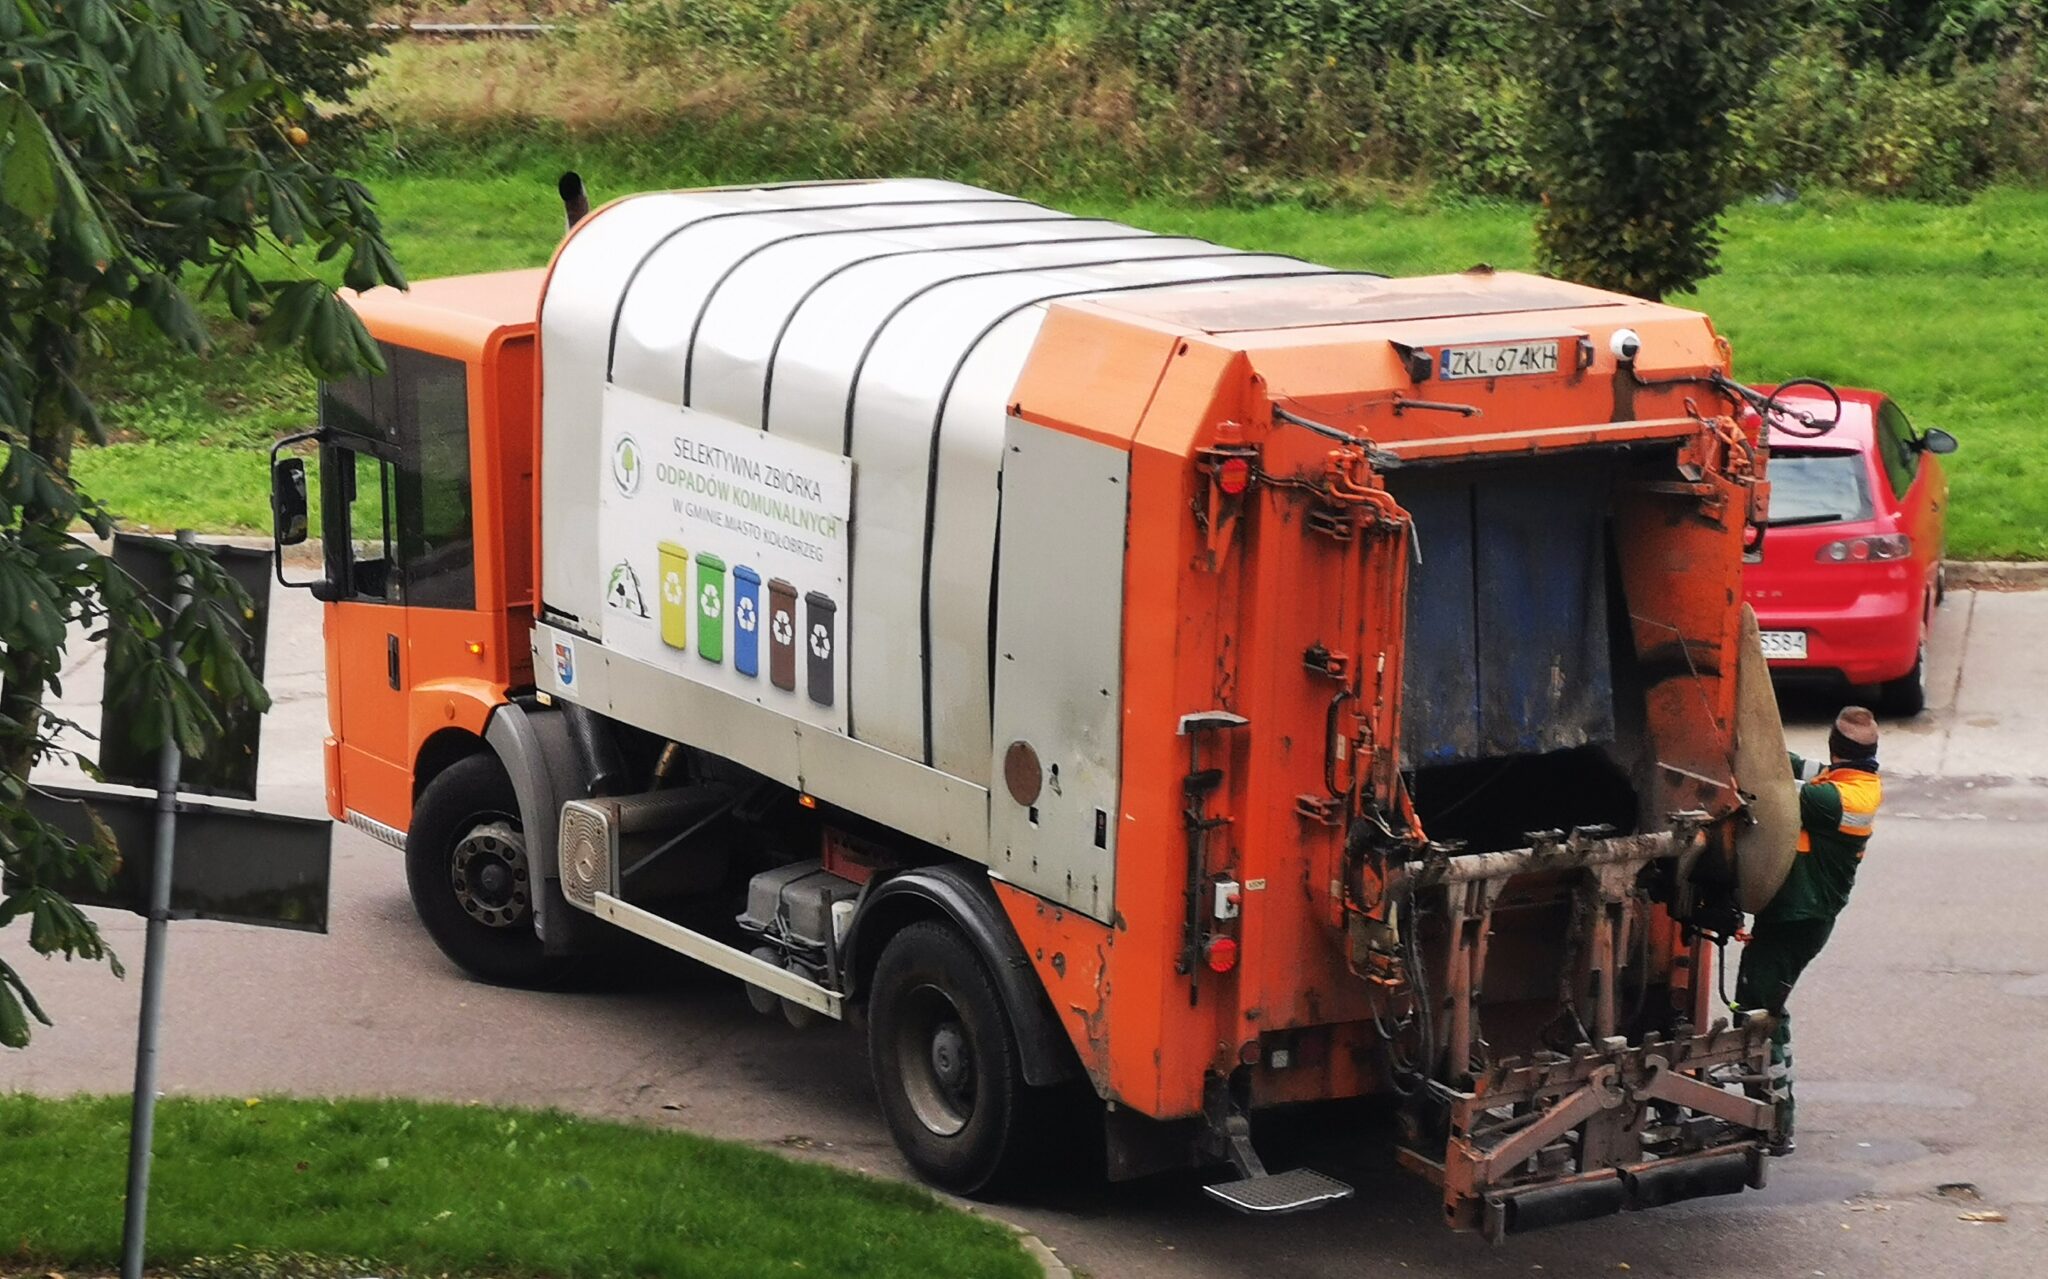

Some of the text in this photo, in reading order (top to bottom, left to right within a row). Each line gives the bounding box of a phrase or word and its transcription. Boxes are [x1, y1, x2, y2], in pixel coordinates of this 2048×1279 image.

[1451, 345, 1558, 376] ZKL 674KH
[656, 462, 837, 540] ODPADÓW KOMUNALNYCH
[673, 435, 822, 503] SELEKTYWNA ZBIÓRKA
[672, 497, 824, 563] W GMINIE MIASTO KOŁOBRZEG
